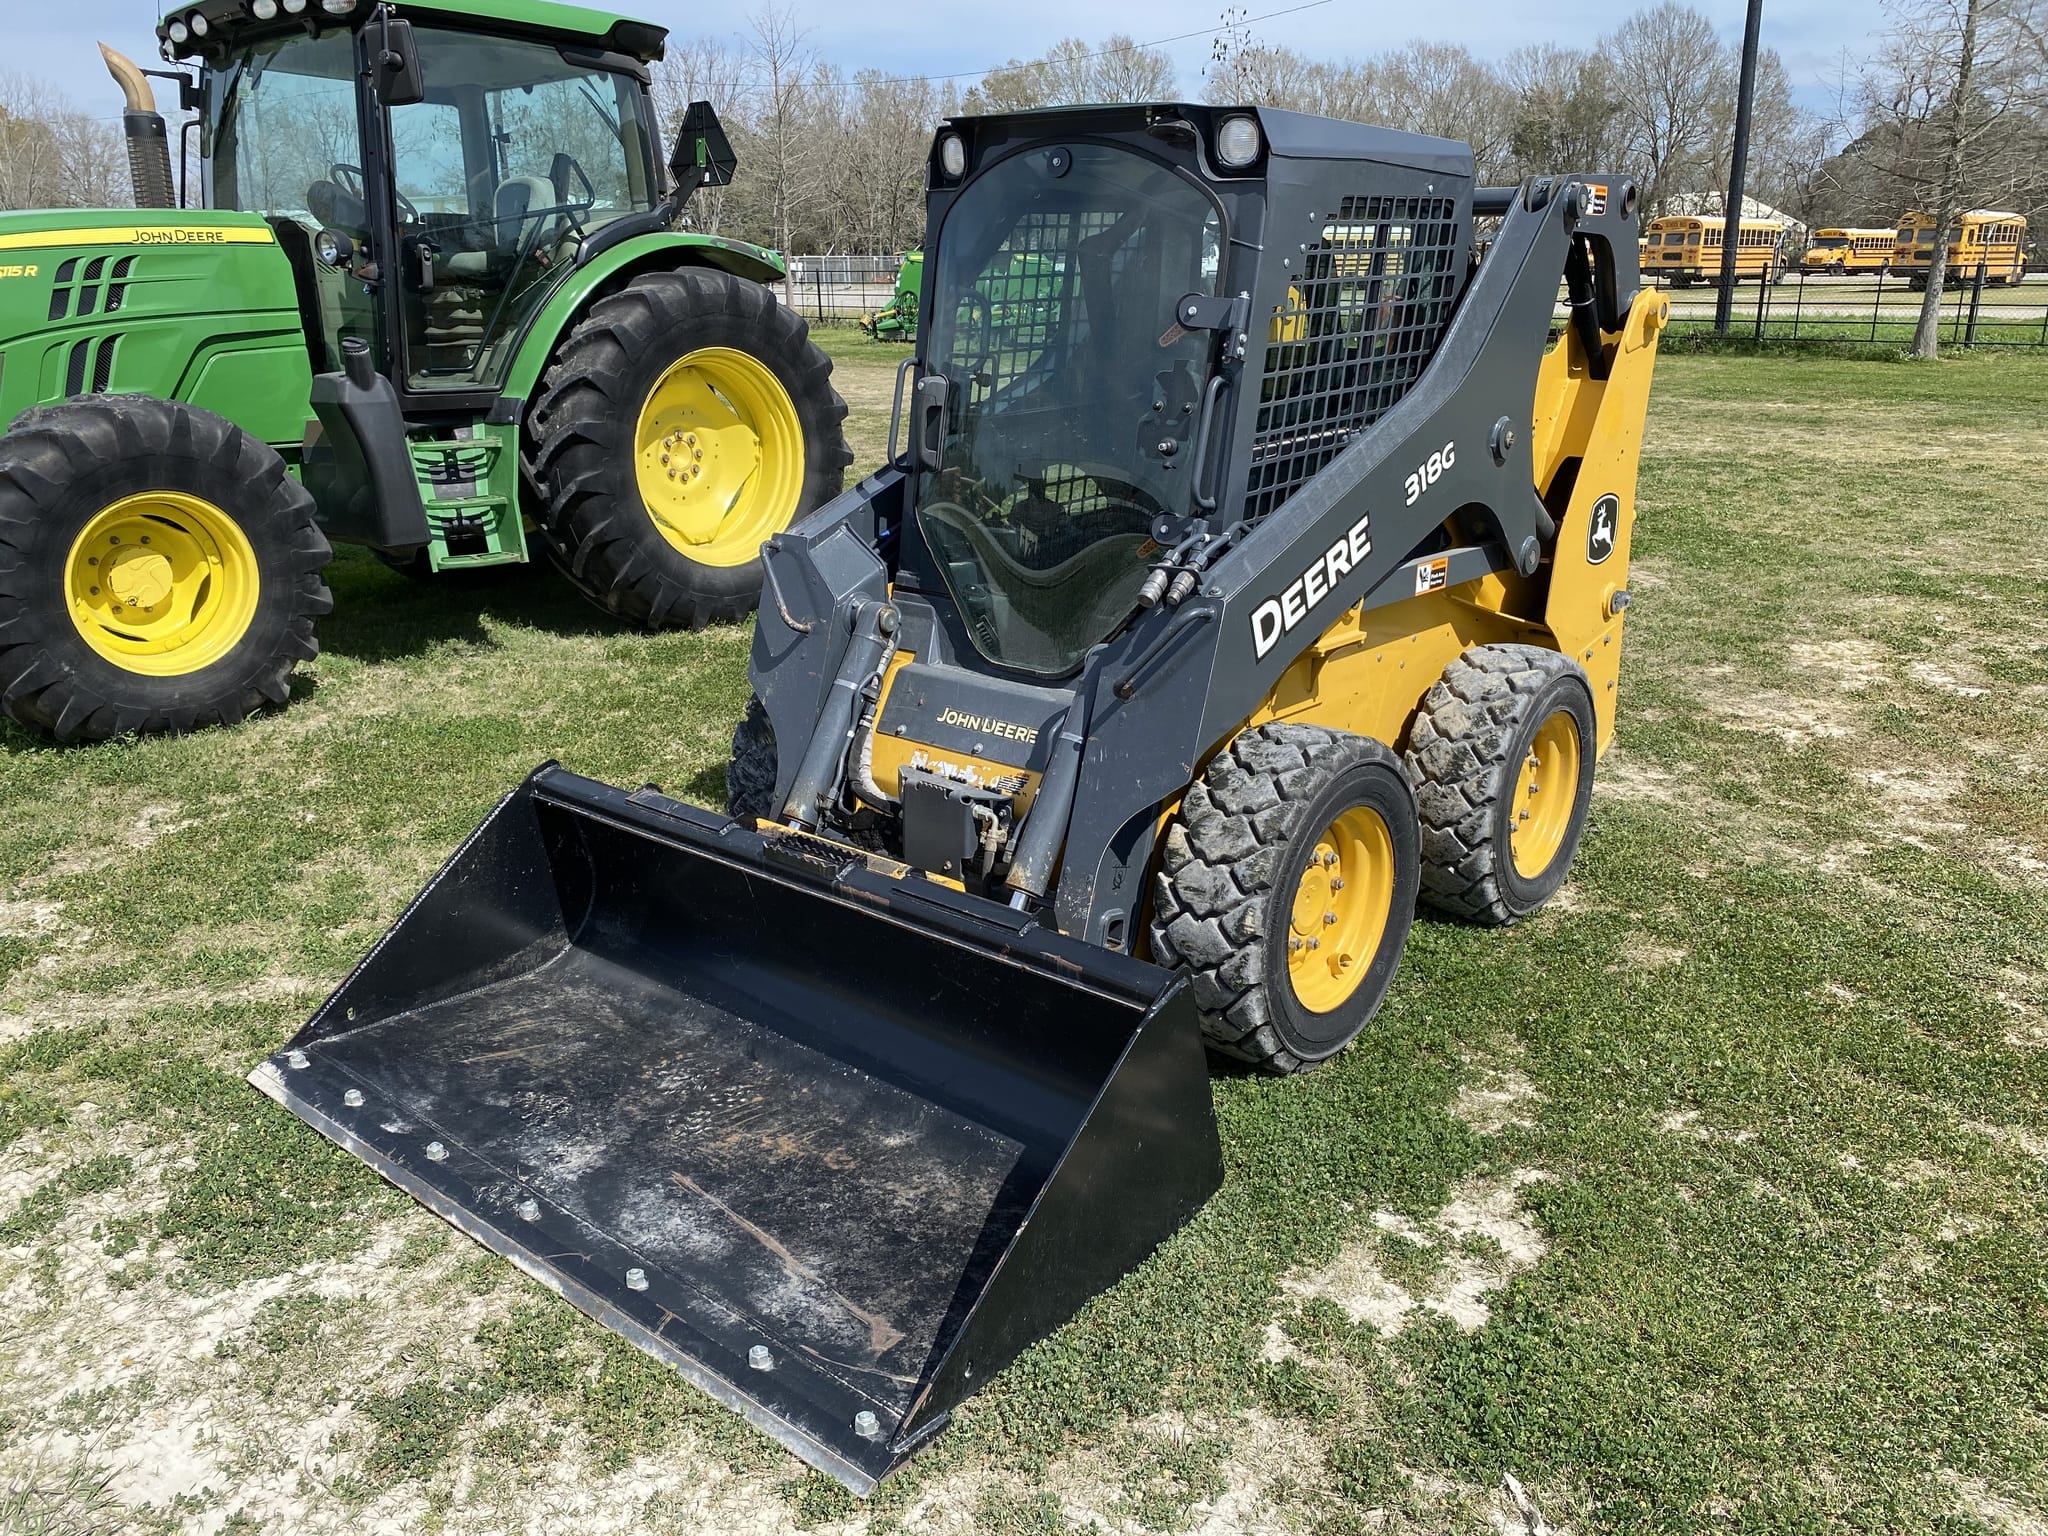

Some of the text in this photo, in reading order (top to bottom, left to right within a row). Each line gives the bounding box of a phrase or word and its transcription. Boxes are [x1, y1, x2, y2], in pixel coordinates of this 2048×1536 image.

[132, 229, 225, 242] JOHN DEERE
[1404, 440, 1455, 507] 318G
[1251, 514, 1372, 659] DEERE
[936, 706, 1039, 745] JOHN DEERE
